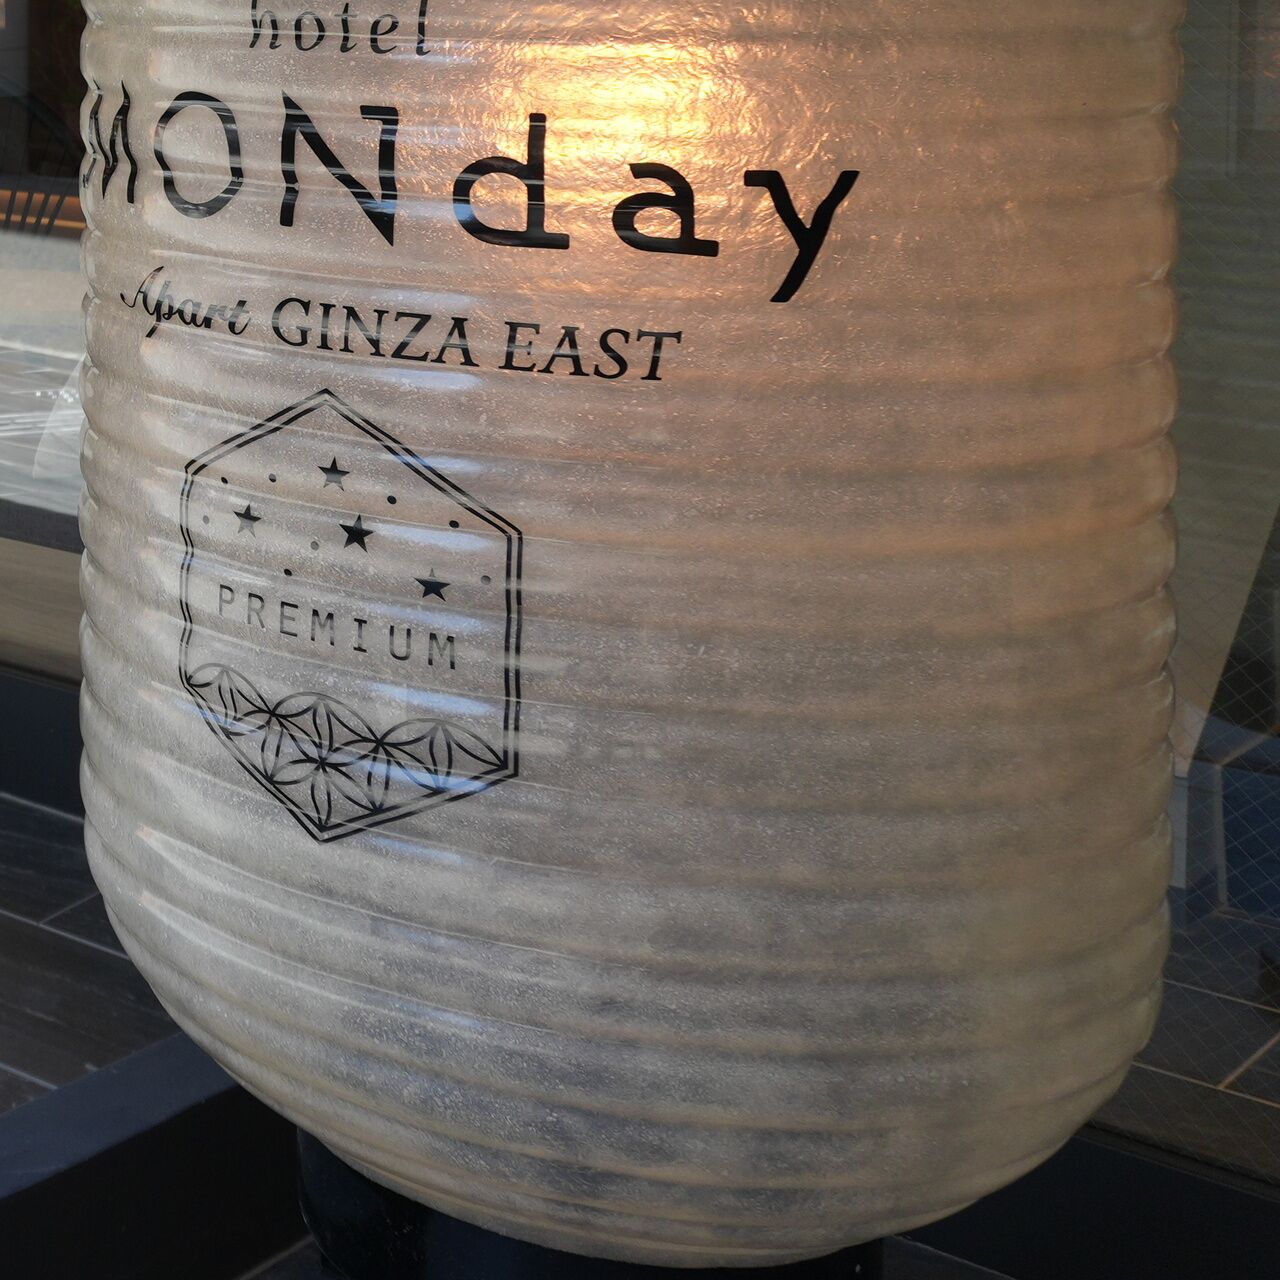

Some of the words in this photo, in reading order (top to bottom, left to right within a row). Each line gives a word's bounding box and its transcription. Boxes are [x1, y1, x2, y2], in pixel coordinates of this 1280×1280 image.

[80, 77, 861, 304] MONday
[120, 266, 250, 338] Apart
[271, 297, 480, 367] GINZA
[498, 321, 683, 381] EAST
[217, 583, 459, 670] PREMIUM
